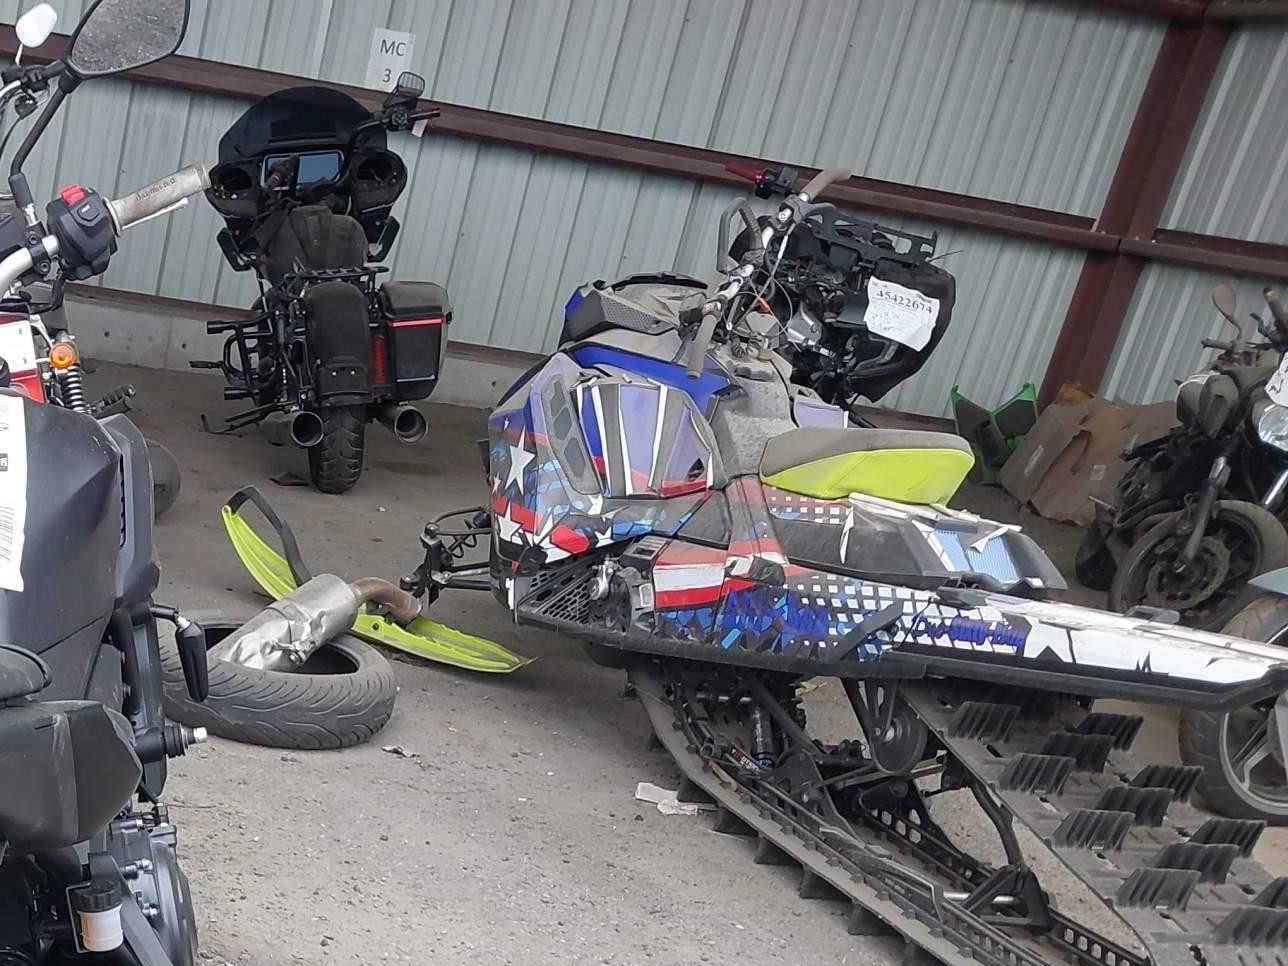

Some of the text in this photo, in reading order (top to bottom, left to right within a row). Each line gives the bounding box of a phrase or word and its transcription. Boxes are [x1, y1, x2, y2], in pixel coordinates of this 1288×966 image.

[380, 39, 407, 57] MC
[382, 68, 392, 83] 3
[135, 177, 176, 201] domino
